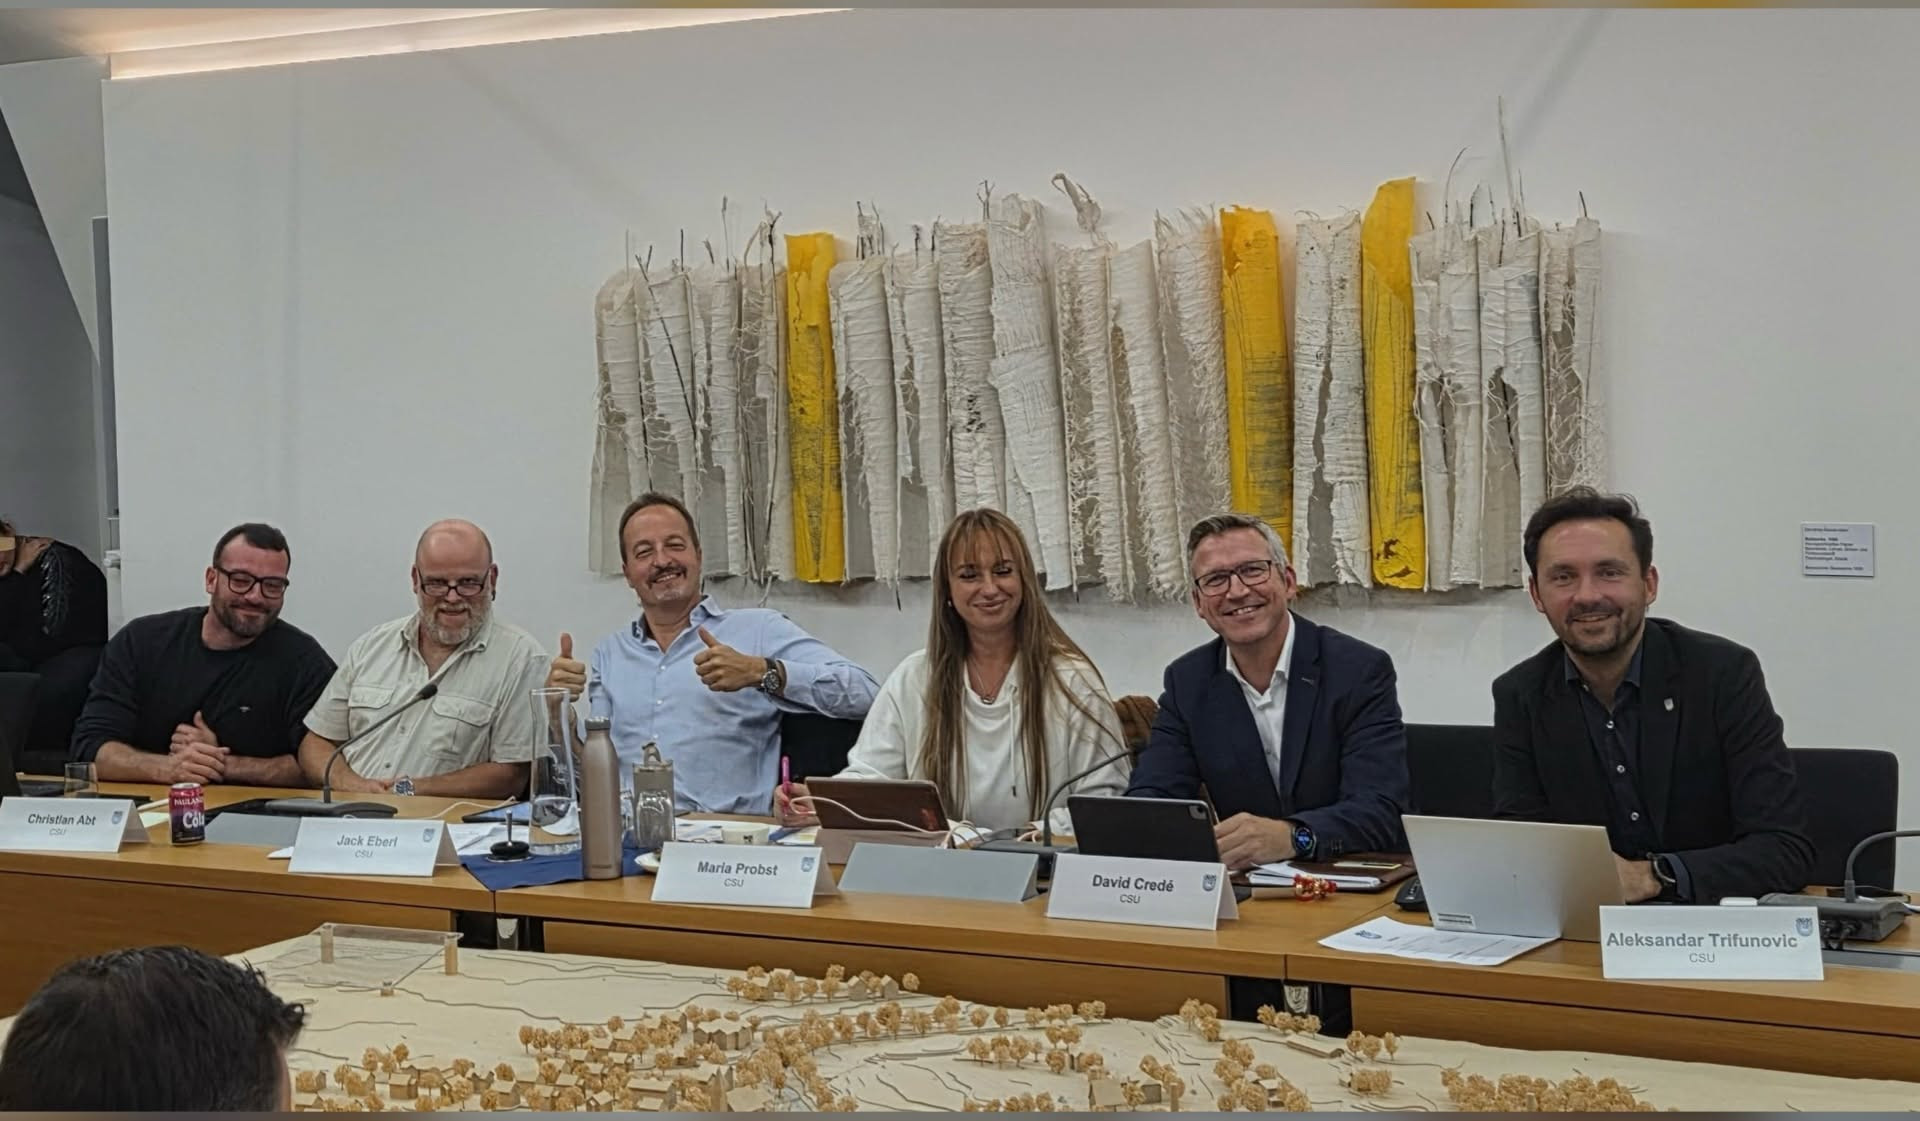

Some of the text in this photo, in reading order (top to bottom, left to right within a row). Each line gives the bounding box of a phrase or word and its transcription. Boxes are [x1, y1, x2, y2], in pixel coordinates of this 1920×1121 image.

[27, 813, 96, 826] Christian Abt
[49, 828, 66, 836] CSU
[336, 834, 399, 848] Jack Eberl
[354, 849, 374, 858] CSU
[697, 861, 778, 876] Maria Probst
[723, 878, 745, 888] CSU
[1092, 874, 1175, 893] David Credé
[1119, 894, 1141, 904] CSU
[1606, 932, 1798, 949] Aleksandar Trifunovic
[1688, 952, 1716, 964] CSU
